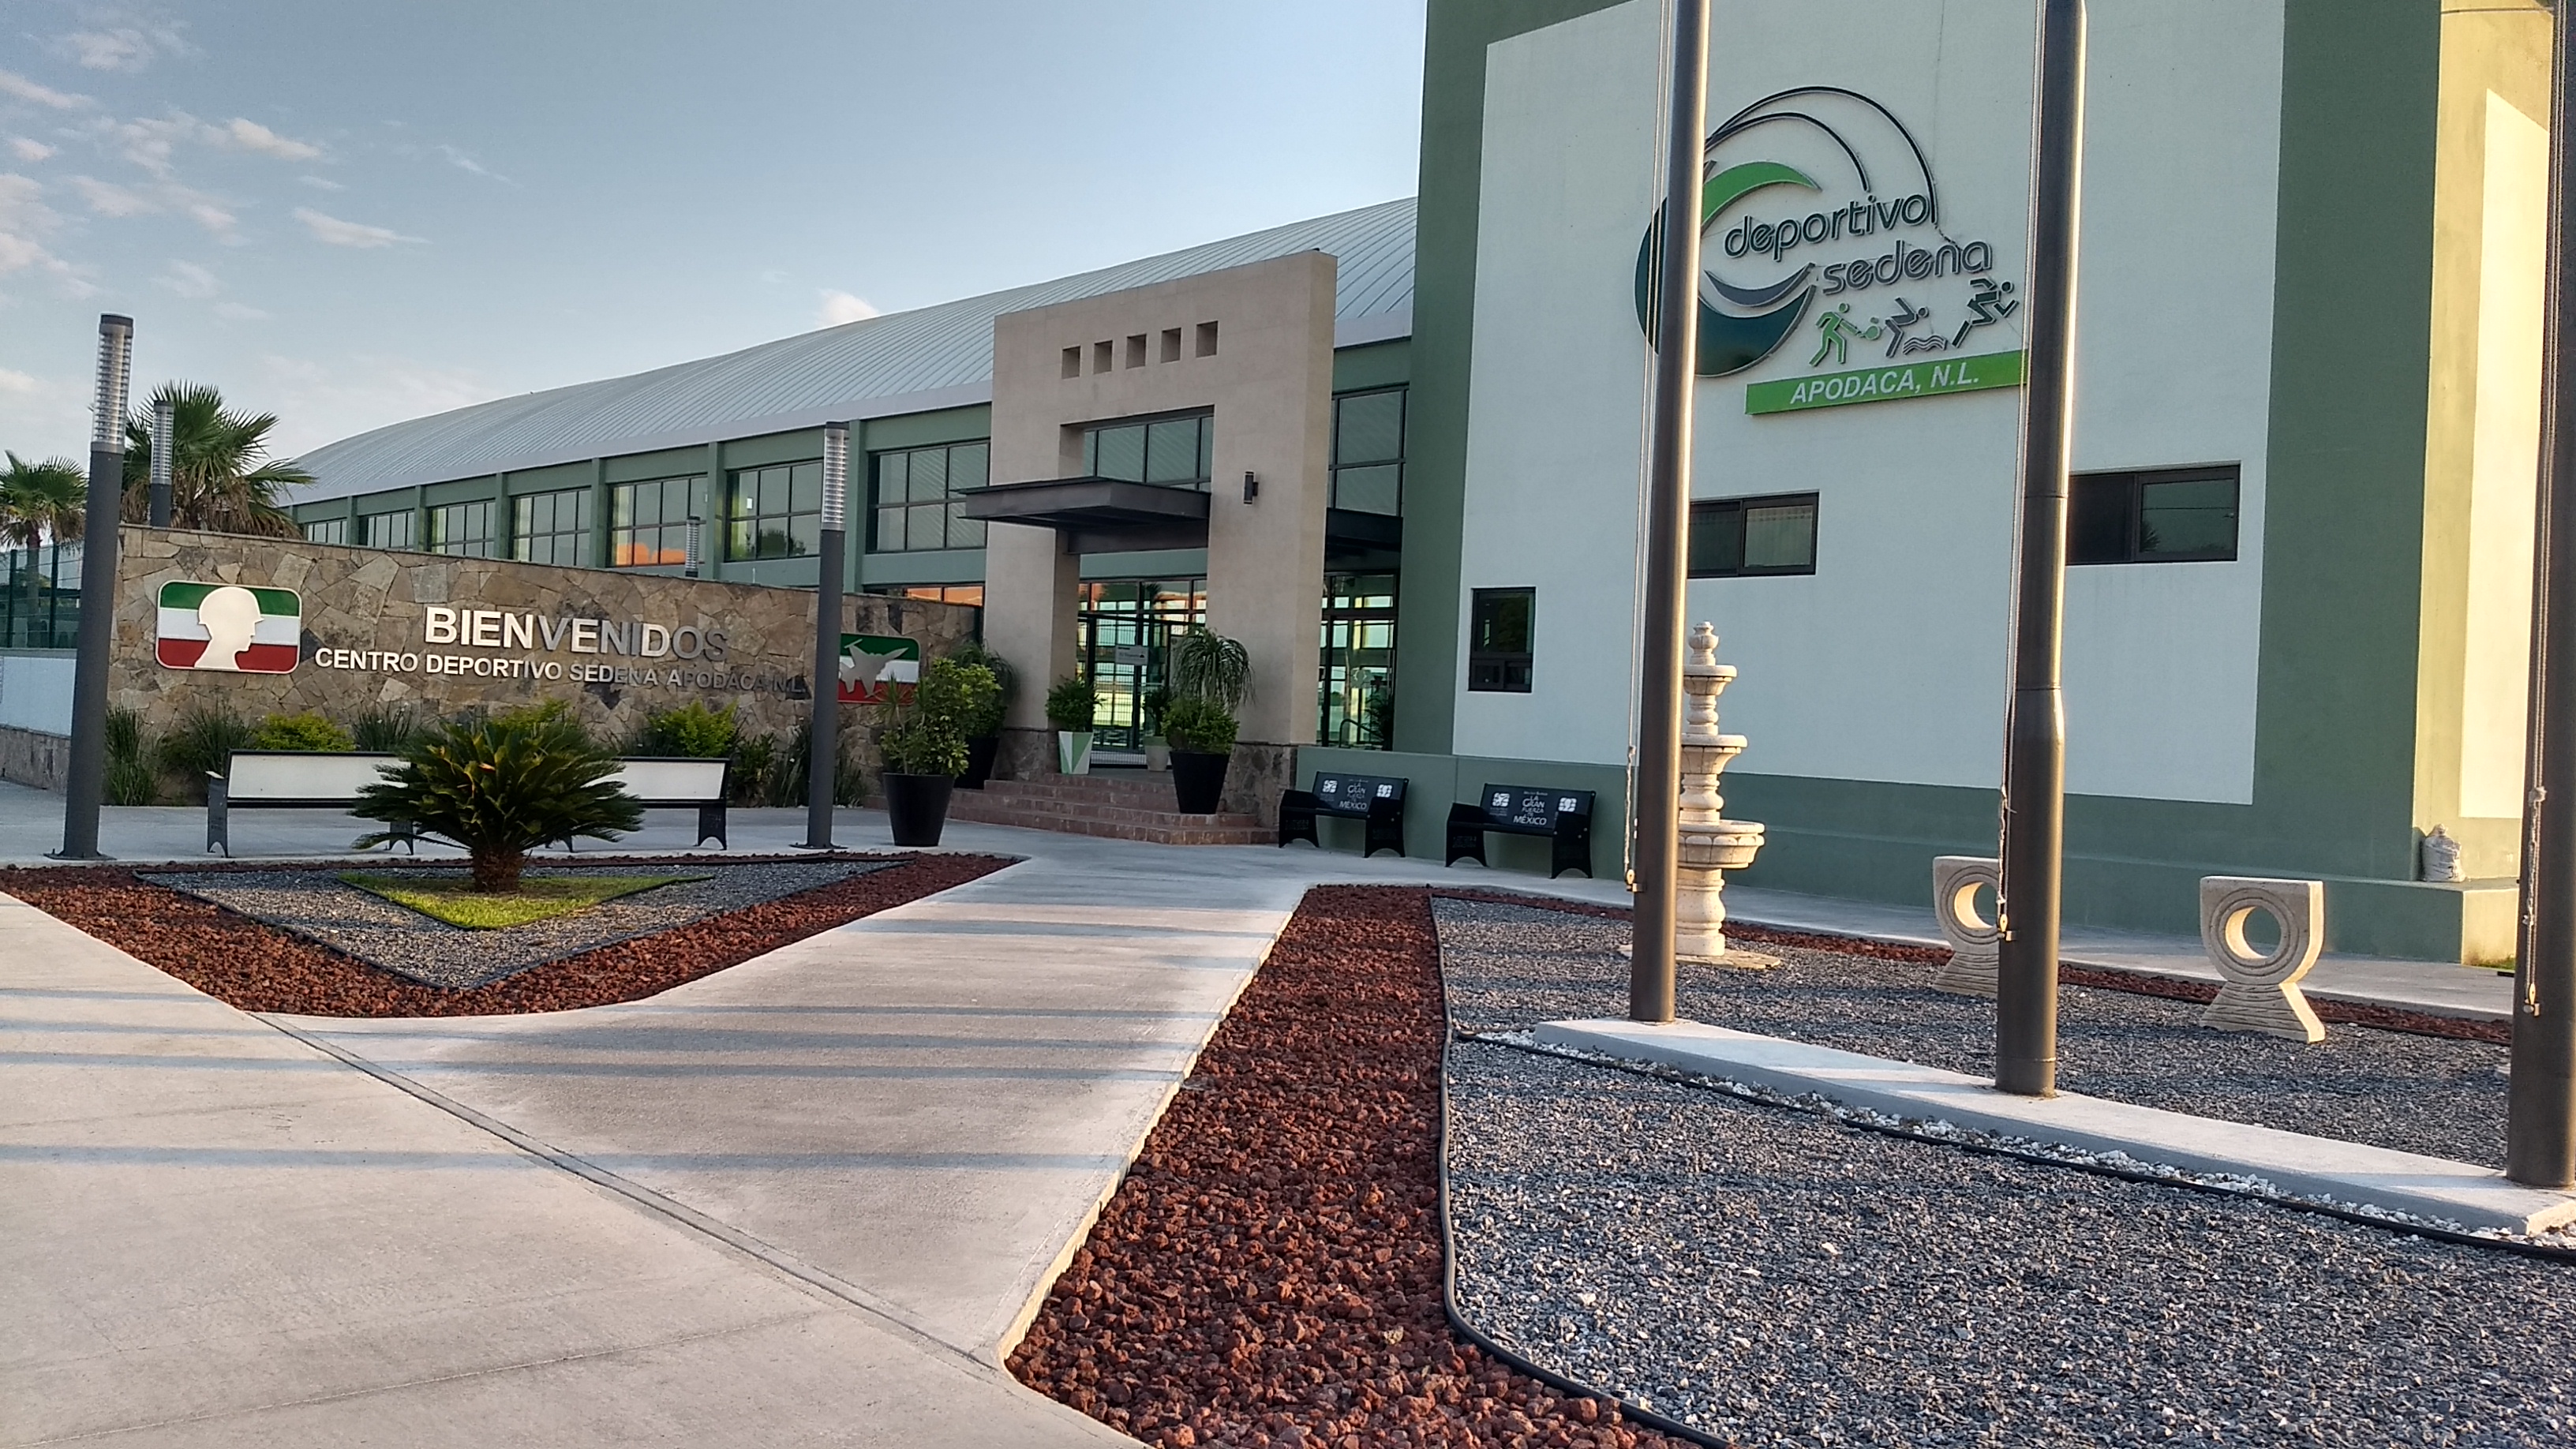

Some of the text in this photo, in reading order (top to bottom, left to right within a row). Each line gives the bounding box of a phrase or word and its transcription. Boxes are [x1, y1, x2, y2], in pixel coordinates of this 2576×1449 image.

[1724, 194, 1930, 262] deportivo
[1822, 240, 1993, 295] sedena
[1789, 361, 1979, 405] APODACA, N.L.
[424, 606, 730, 661] BIENVENIDOS
[315, 648, 419, 672] CENTRO
[426, 654, 563, 680] DEPORTIVO
[569, 664, 658, 687] SEDENA
[666, 669, 766, 693] APODACA
[1513, 814, 1548, 826] MÉXICO
[1522, 798, 1545, 808] GRAN
